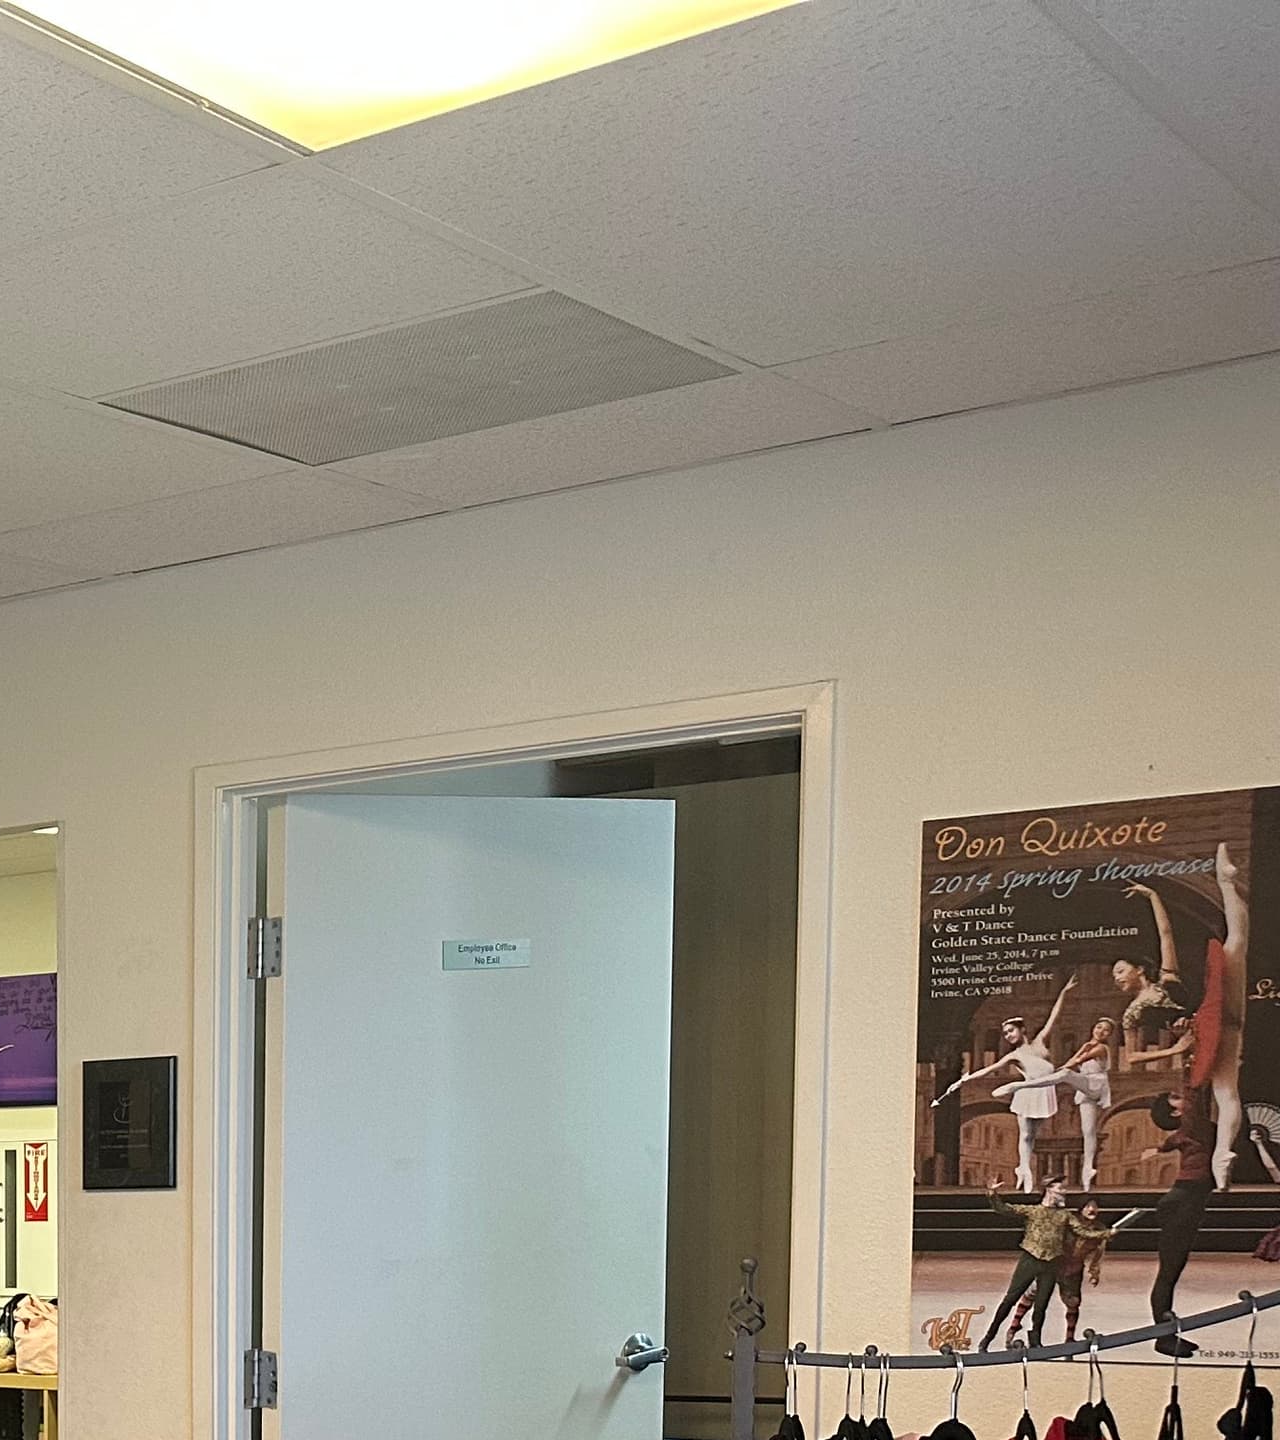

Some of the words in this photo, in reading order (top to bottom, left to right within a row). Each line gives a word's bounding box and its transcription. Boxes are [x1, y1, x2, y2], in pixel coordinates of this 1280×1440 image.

[934, 825, 1006, 861] Don
[1020, 816, 1168, 857] Quixote
[928, 873, 991, 895] 2014
[933, 904, 996, 919] Presented
[999, 903, 1016, 917] by
[932, 923, 943, 933] V
[945, 922, 960, 933] &
[961, 921, 972, 931] T
[975, 920, 1015, 931] Dance
[931, 935, 977, 949] Golden
[980, 934, 1015, 946] State
[1017, 932, 1059, 943] Dance
[1061, 924, 1139, 940] Foundation
[457, 943, 493, 954] Employee
[494, 942, 517, 952] Office
[474, 956, 485, 965] No
[486, 955, 501, 964] Exit
[960, 953, 984, 964] June
[1031, 948, 1038, 958] 7
[931, 966, 961, 976] Irvine
[962, 963, 994, 974] Valley
[996, 961, 1035, 972] College
[957, 976, 987, 986] Irvine
[988, 974, 1024, 984] Center
[1025, 972, 1055, 982] Drive
[964, 987, 981, 997] CA
